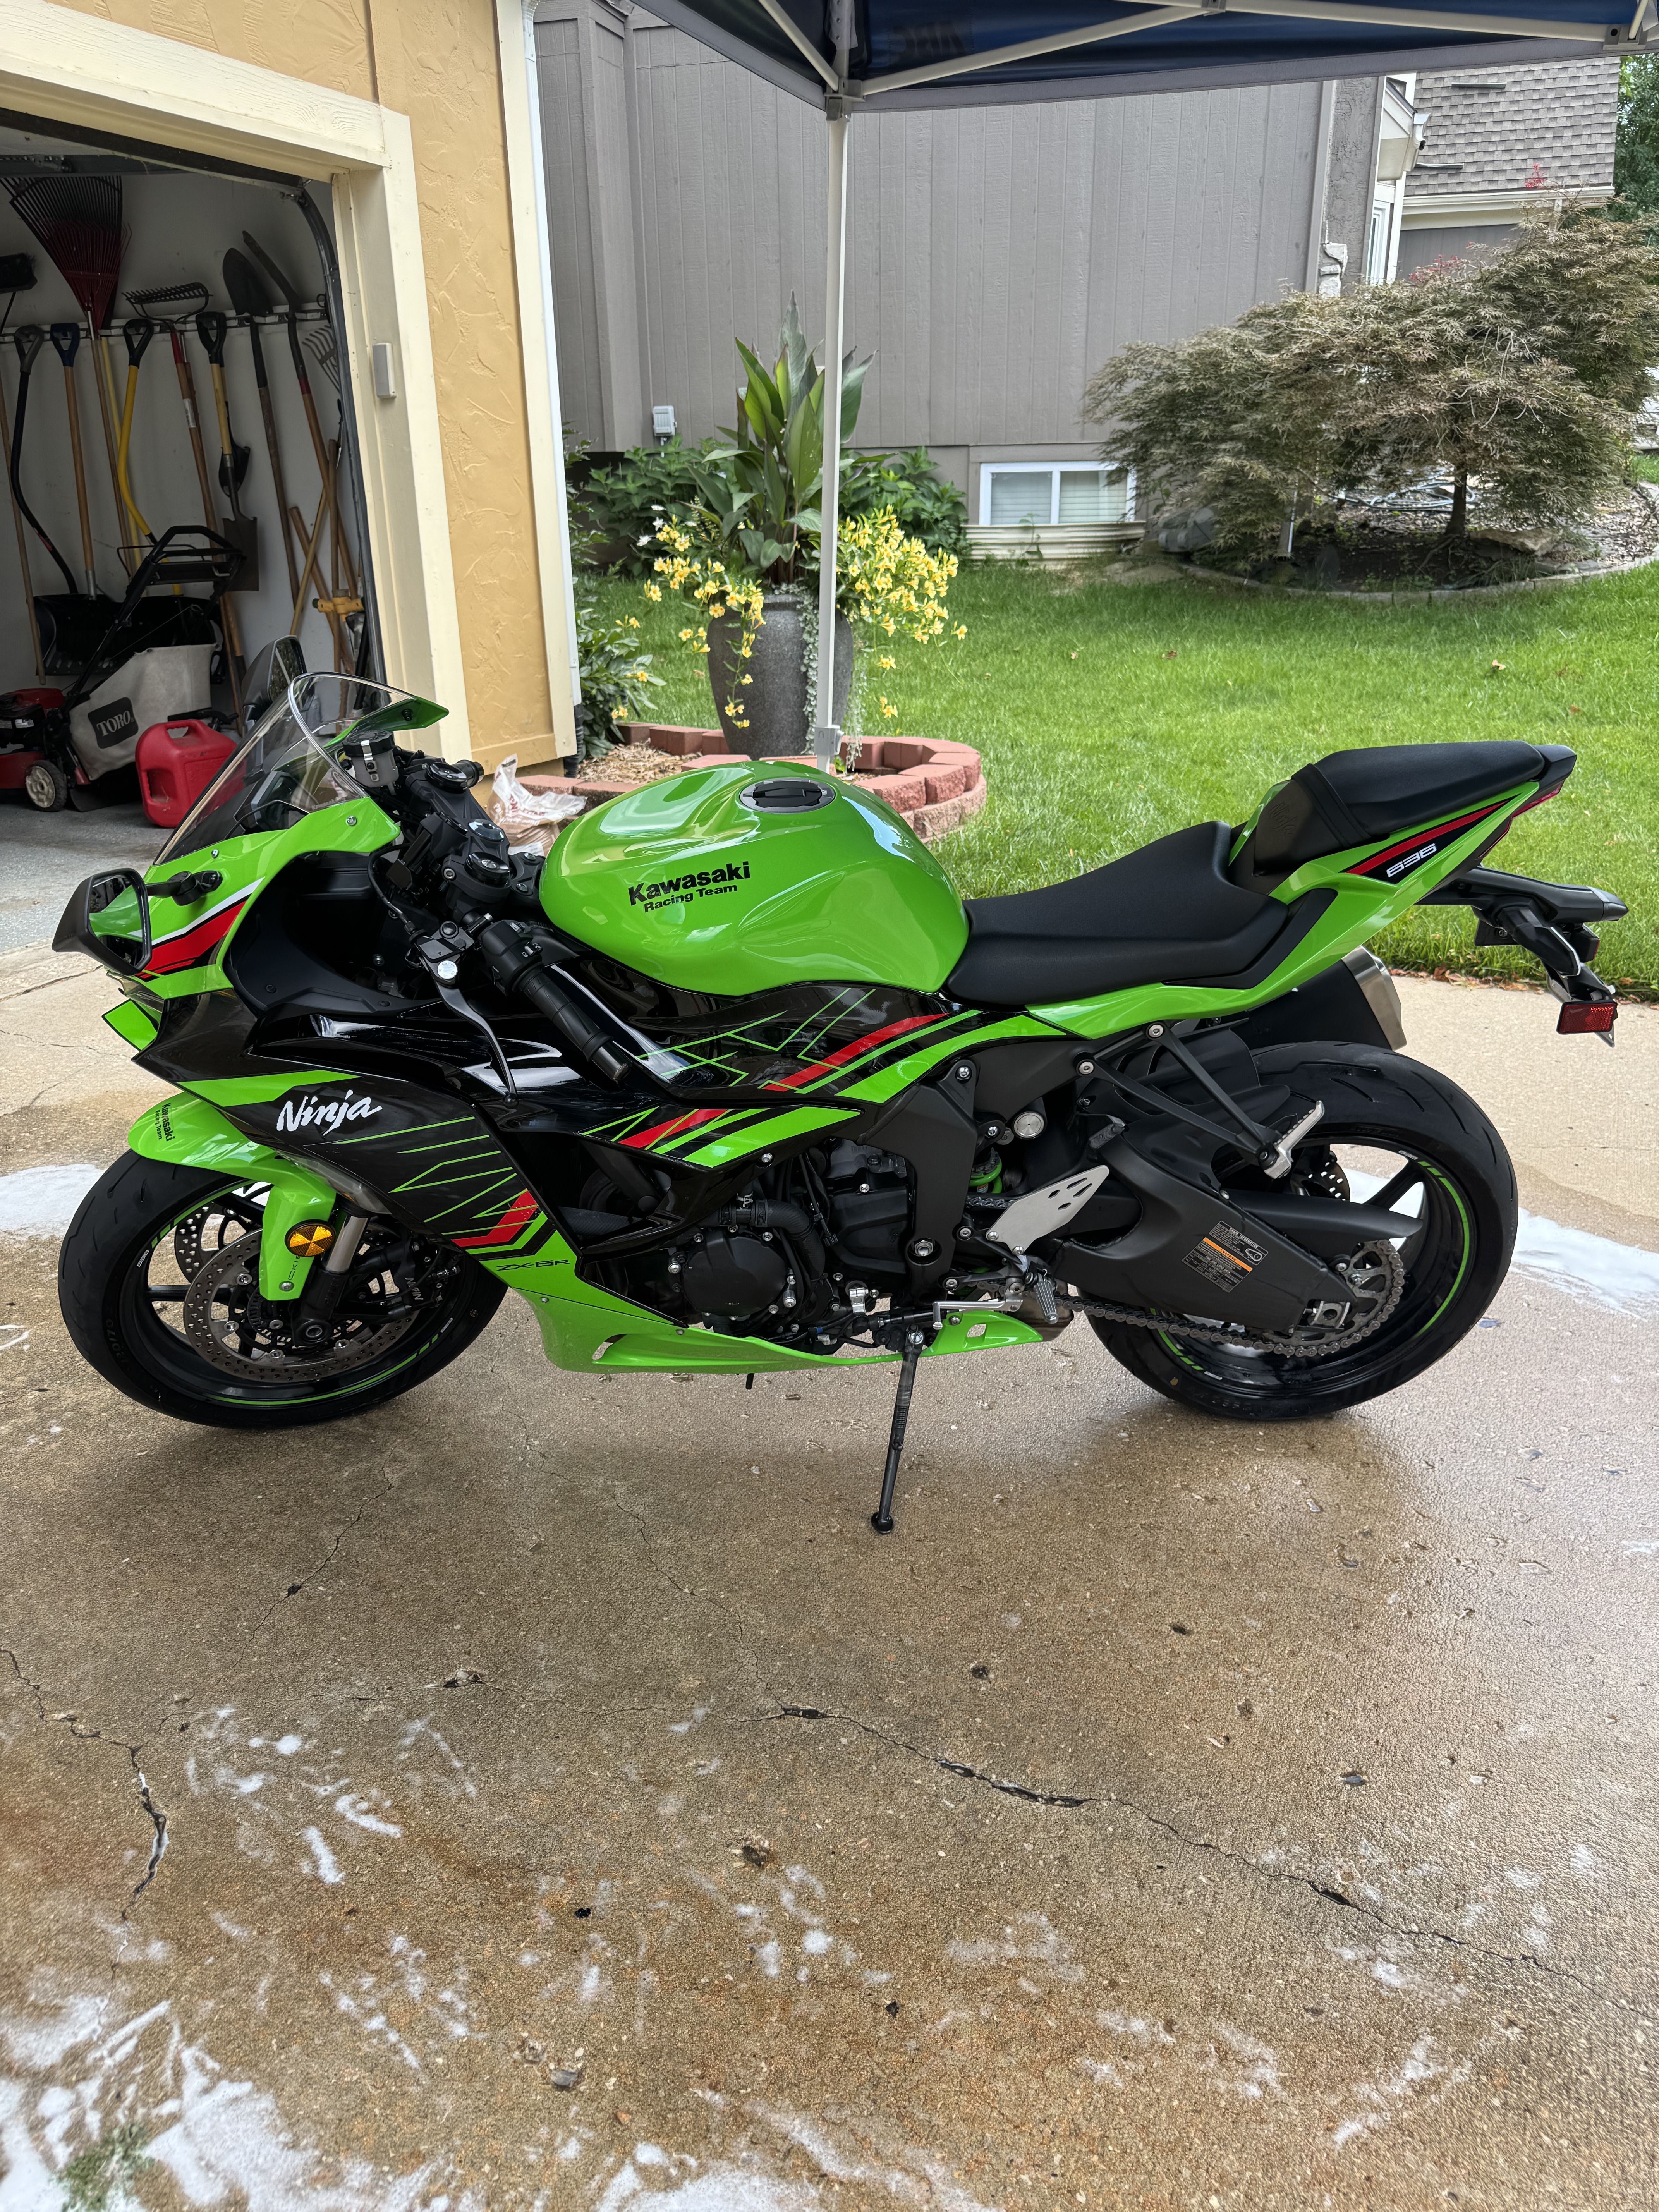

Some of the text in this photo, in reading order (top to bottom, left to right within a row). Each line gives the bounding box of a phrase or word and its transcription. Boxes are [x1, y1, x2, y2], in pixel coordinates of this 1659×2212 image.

[96, 710, 131, 736] TORO
[1386, 843, 1437, 878] 636
[628, 861, 750, 906] Kawasaki
[644, 884, 738, 912] Racing Team
[162, 1103, 175, 1142] Kawasaki
[276, 1089, 383, 1136] Ninja
[496, 1259, 570, 1271] ZX-6R
